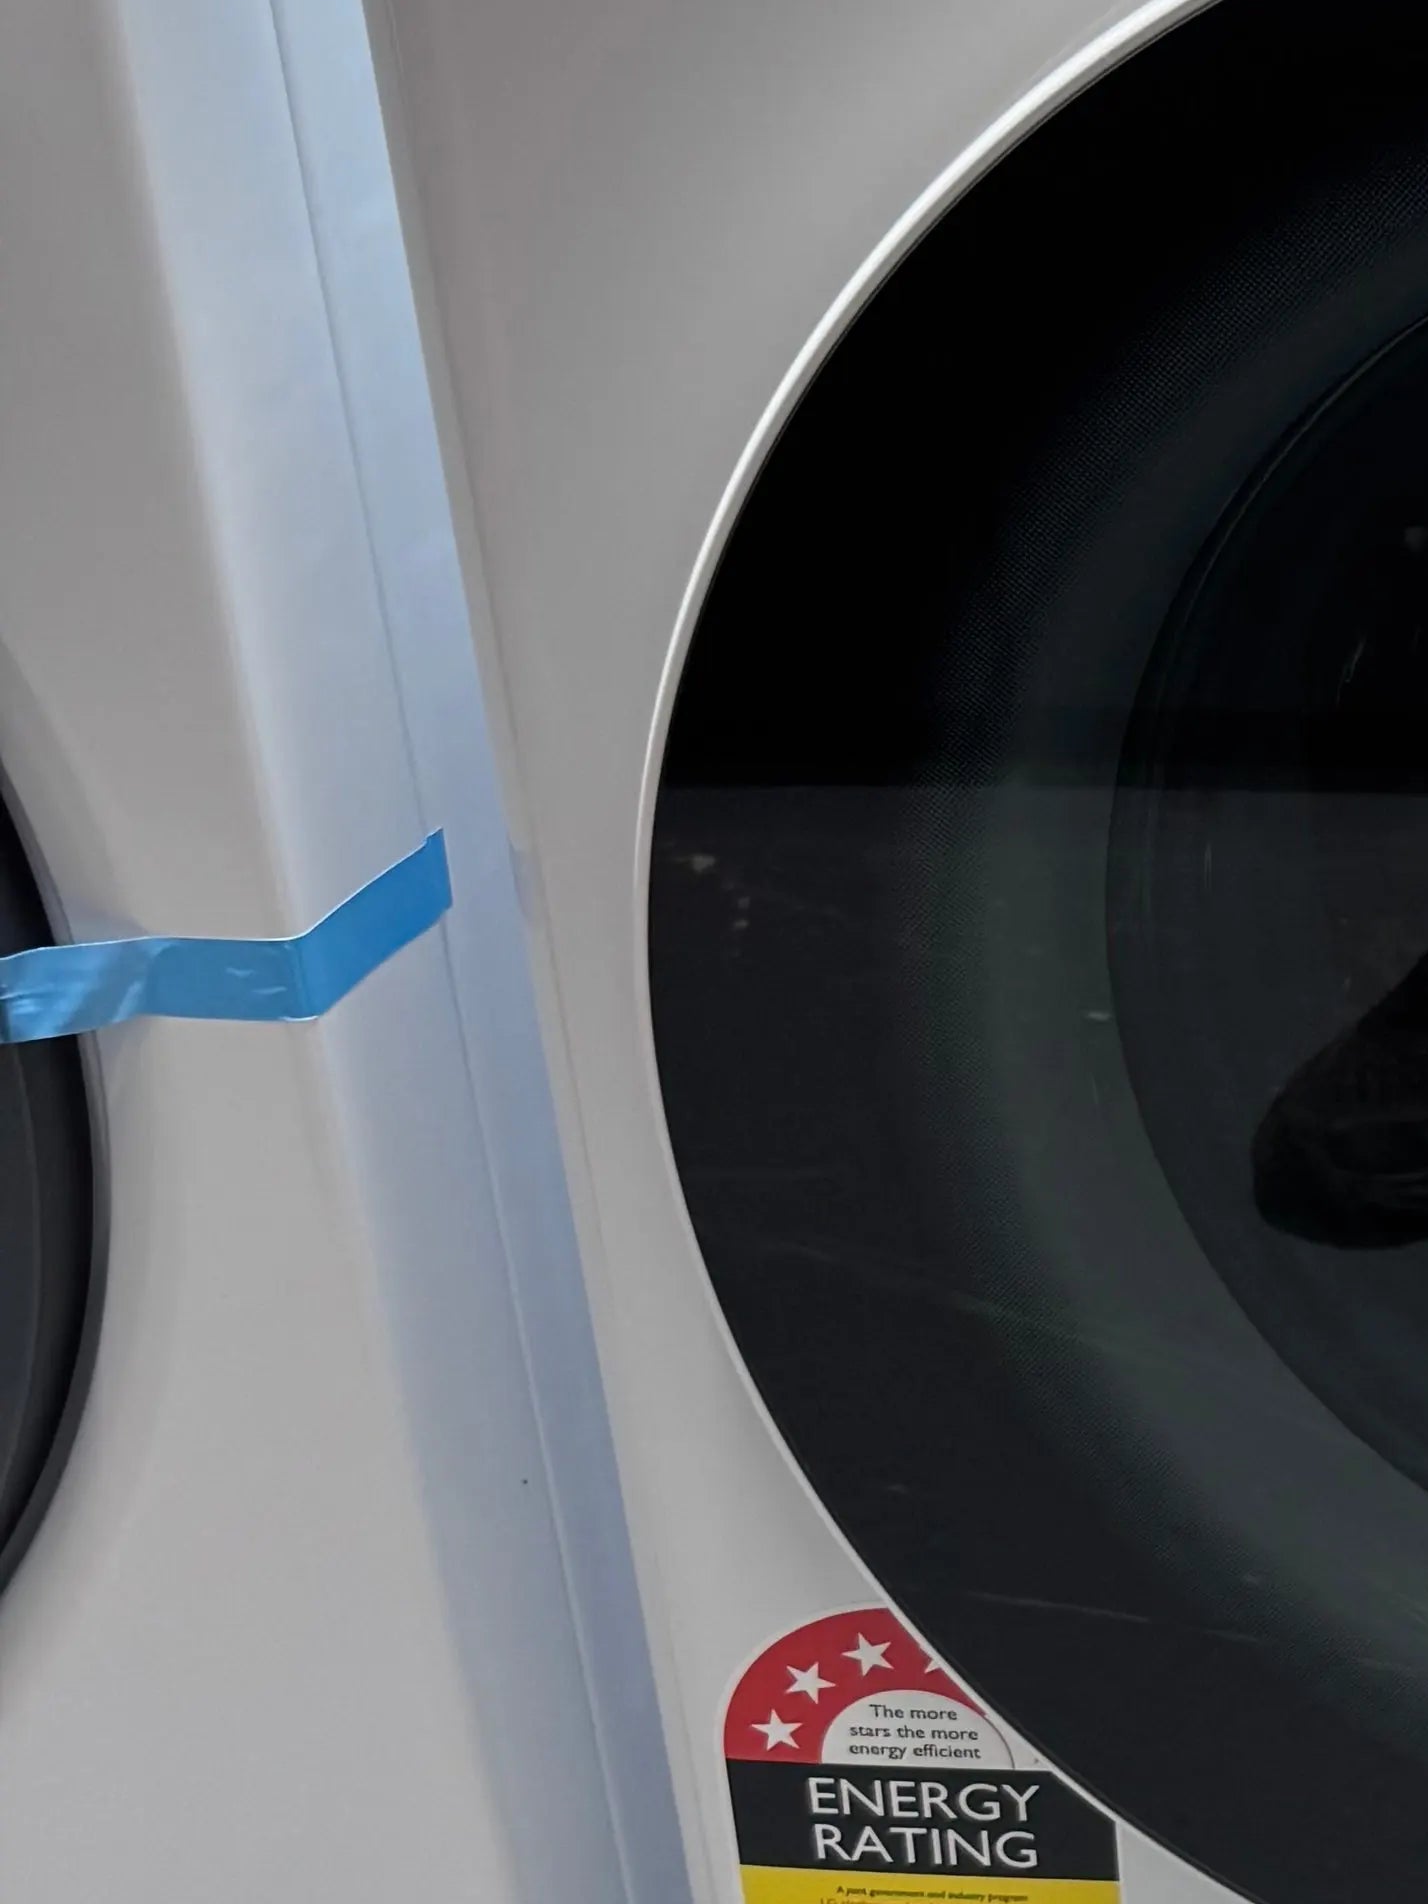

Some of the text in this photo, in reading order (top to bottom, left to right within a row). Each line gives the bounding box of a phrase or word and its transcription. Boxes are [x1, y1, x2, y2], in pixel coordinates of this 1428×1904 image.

[869, 1702, 959, 1723] The more
[848, 1723, 980, 1743] stars the more
[848, 1741, 982, 1761] energy efficient
[806, 1776, 1041, 1824] ENERGY
[812, 1823, 1040, 1871] RATING
